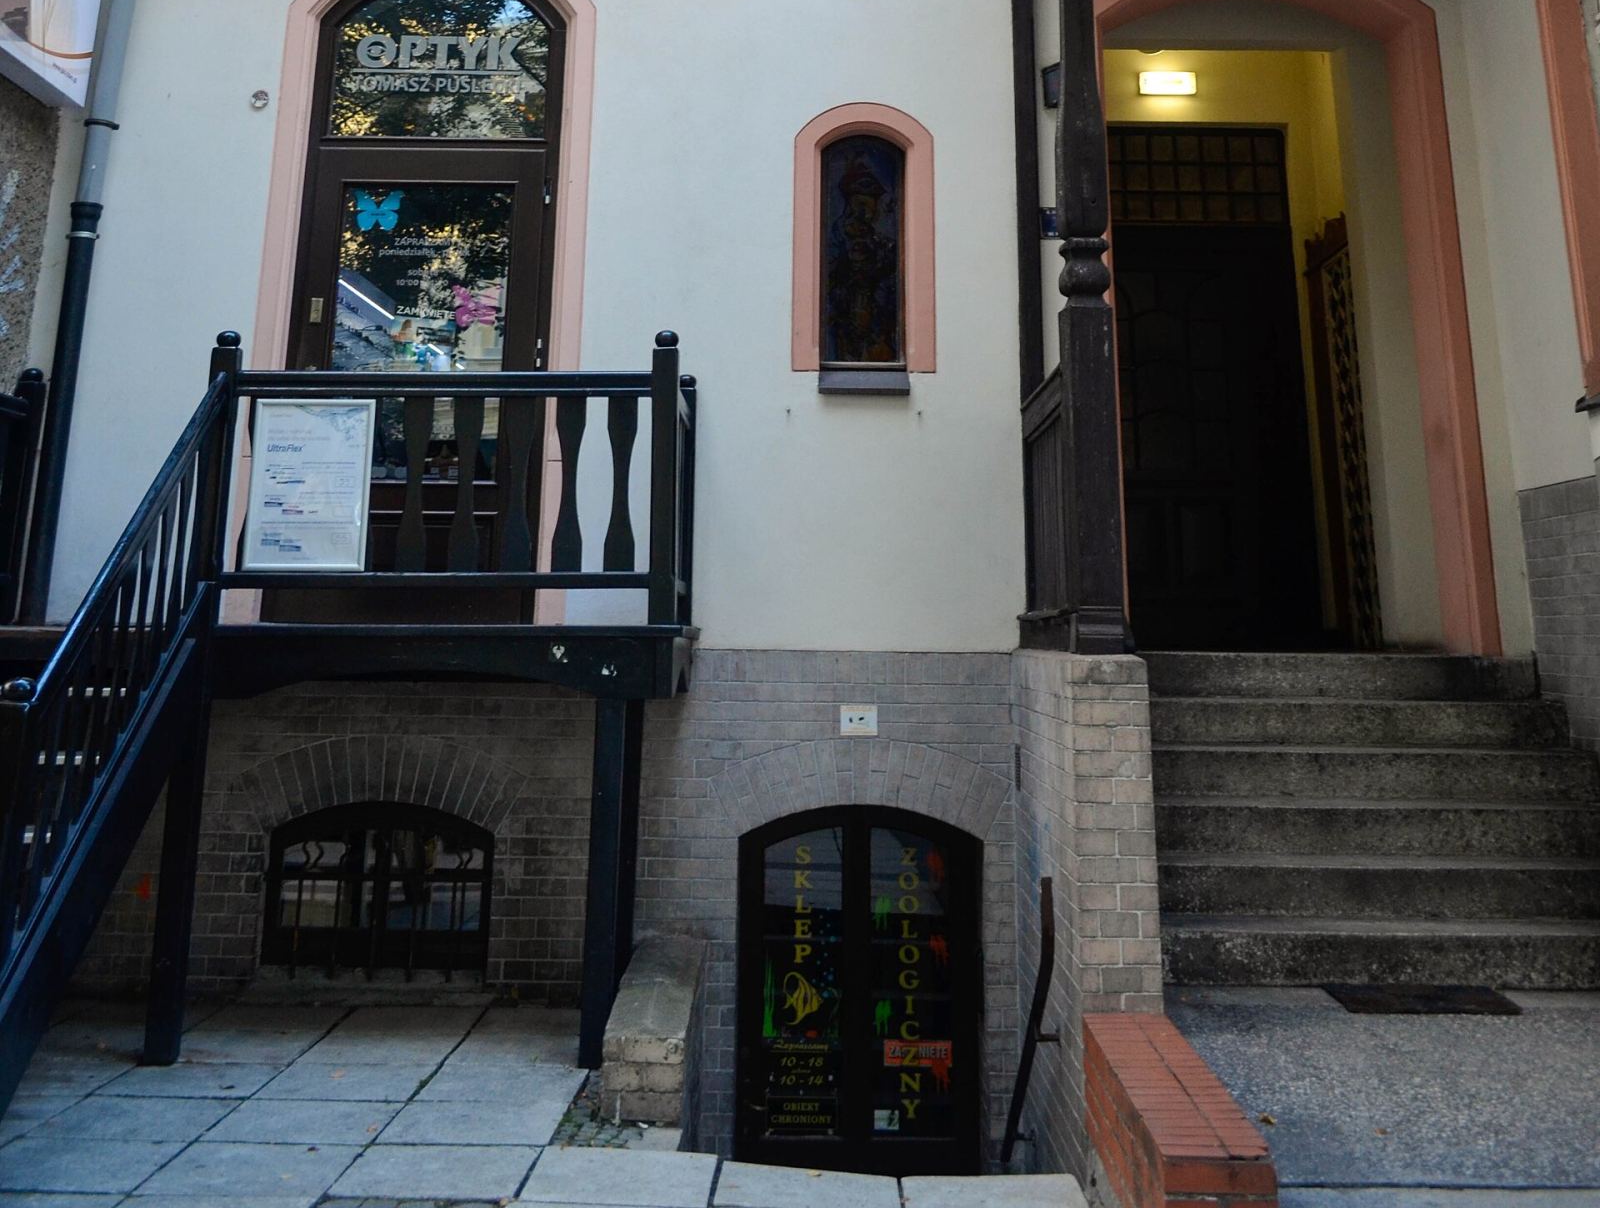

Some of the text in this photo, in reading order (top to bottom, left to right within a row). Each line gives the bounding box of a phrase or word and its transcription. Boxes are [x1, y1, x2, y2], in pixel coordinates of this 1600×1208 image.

[356, 34, 522, 70] OPTYK
[353, 74, 430, 93] TOMASZ
[794, 845, 813, 964] SKLEP
[898, 847, 921, 1119] ZOOLOGICZNY
[780, 1056, 797, 1067] 10
[808, 1056, 824, 1067] 18
[780, 1074, 796, 1086] 10
[770, 1114, 833, 1125] CHRONIONY
